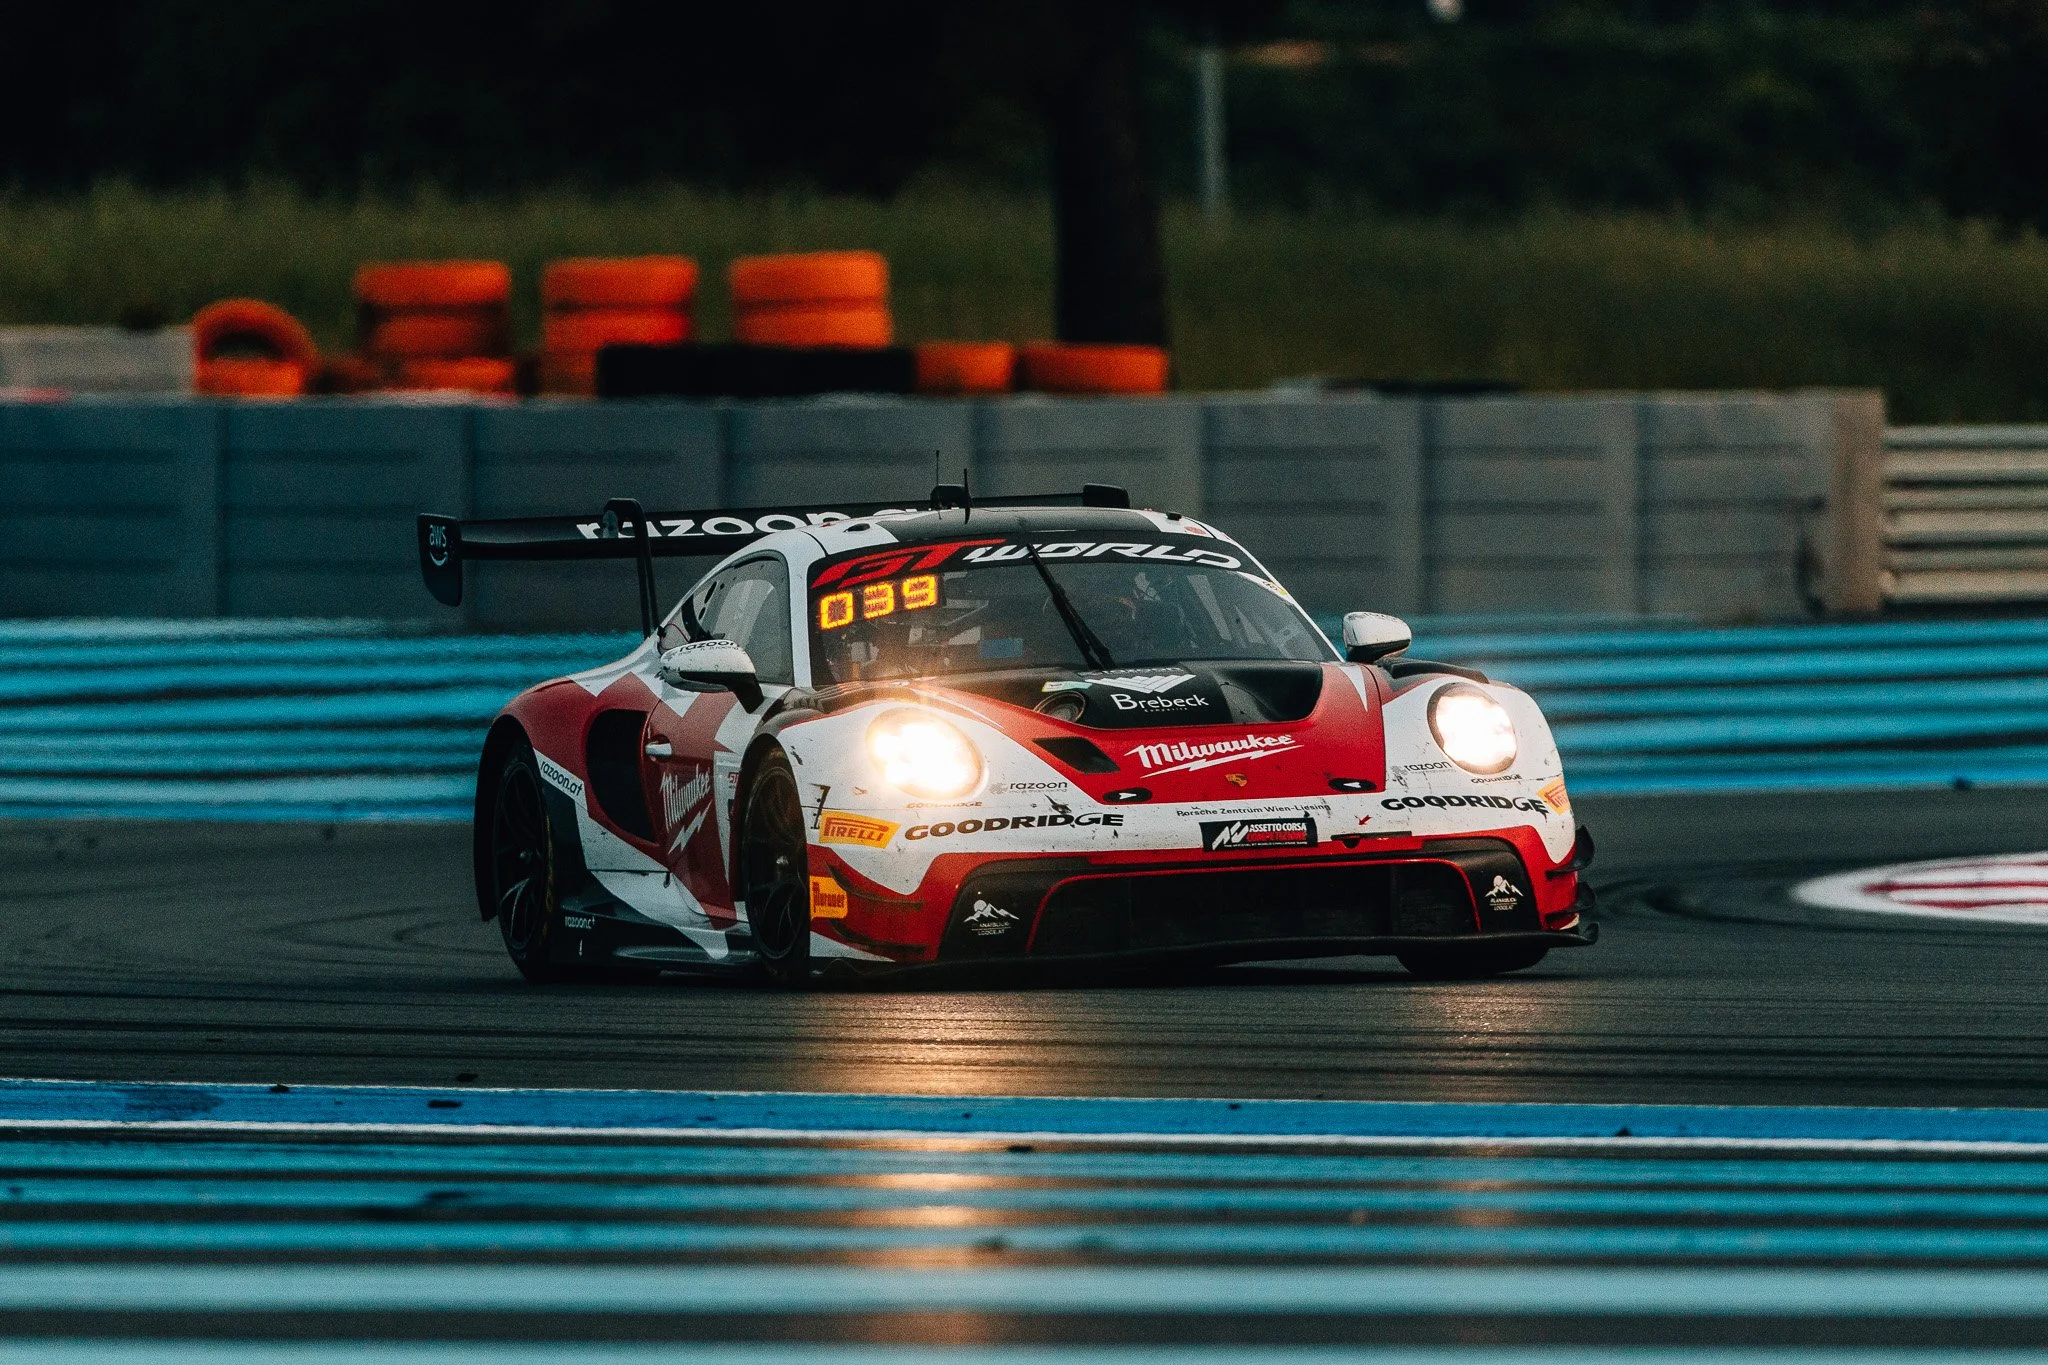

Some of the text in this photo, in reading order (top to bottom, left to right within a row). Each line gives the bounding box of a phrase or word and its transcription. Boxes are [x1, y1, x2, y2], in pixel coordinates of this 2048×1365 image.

[429, 524, 447, 547] aws
[962, 542, 1242, 569] WORLD
[819, 573, 938, 630] 039
[1110, 693, 1209, 710] Brebeck
[1123, 734, 1296, 769] Milwaukee
[1404, 760, 1452, 771] razoon
[540, 760, 582, 796] razoon.at
[1009, 781, 1068, 790] razoon
[659, 763, 711, 833] Milwaukee
[1381, 795, 1549, 814] GOODRIDGE
[1176, 808, 1218, 817] Porsche
[1220, 806, 1263, 815] Zentrum
[824, 816, 889, 841] PIRELLI
[904, 812, 1124, 841] GOODRIDGE
[1248, 822, 1307, 833] ASSETTO CORSA
